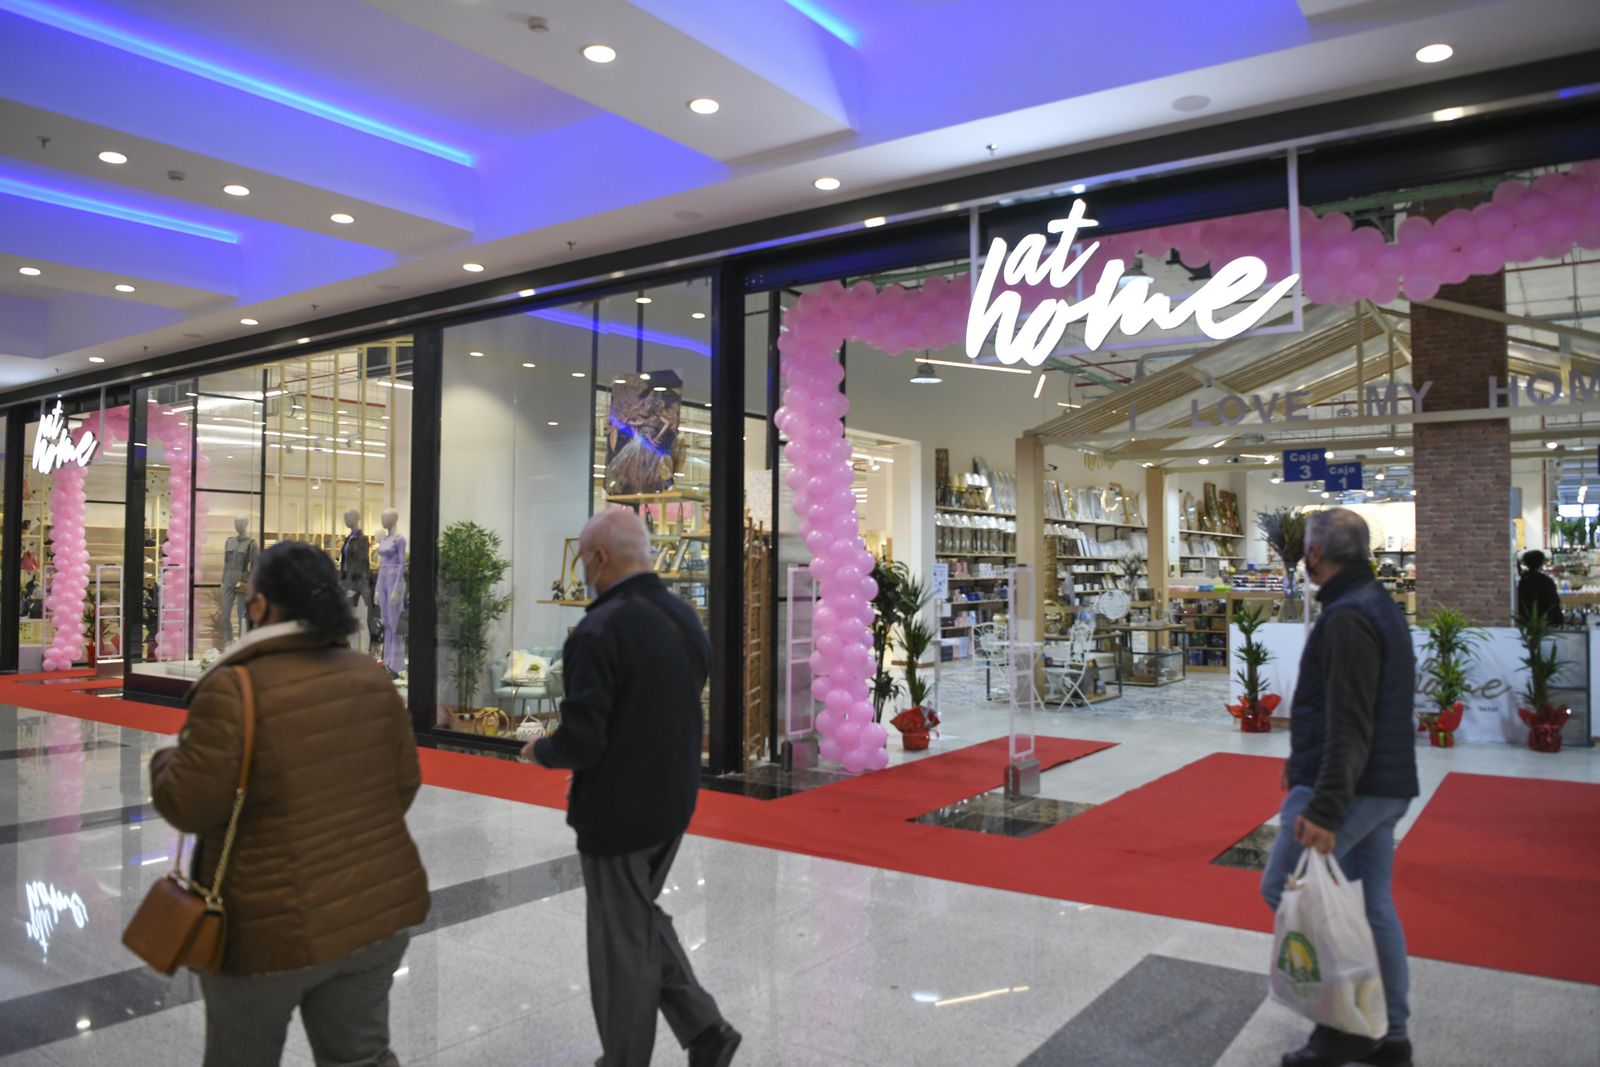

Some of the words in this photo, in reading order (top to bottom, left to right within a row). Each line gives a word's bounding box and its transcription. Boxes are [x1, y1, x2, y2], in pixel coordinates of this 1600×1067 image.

[1004, 199, 1100, 288] at
[966, 237, 1300, 366] home
[1191, 391, 1311, 427] LOVE
[1364, 378, 1435, 418] MY
[32, 414, 97, 474] home
[1289, 451, 1319, 467] Caja
[1299, 465, 1312, 480] 3
[1329, 466, 1356, 481] Caja
[1338, 477, 1348, 489] 1
